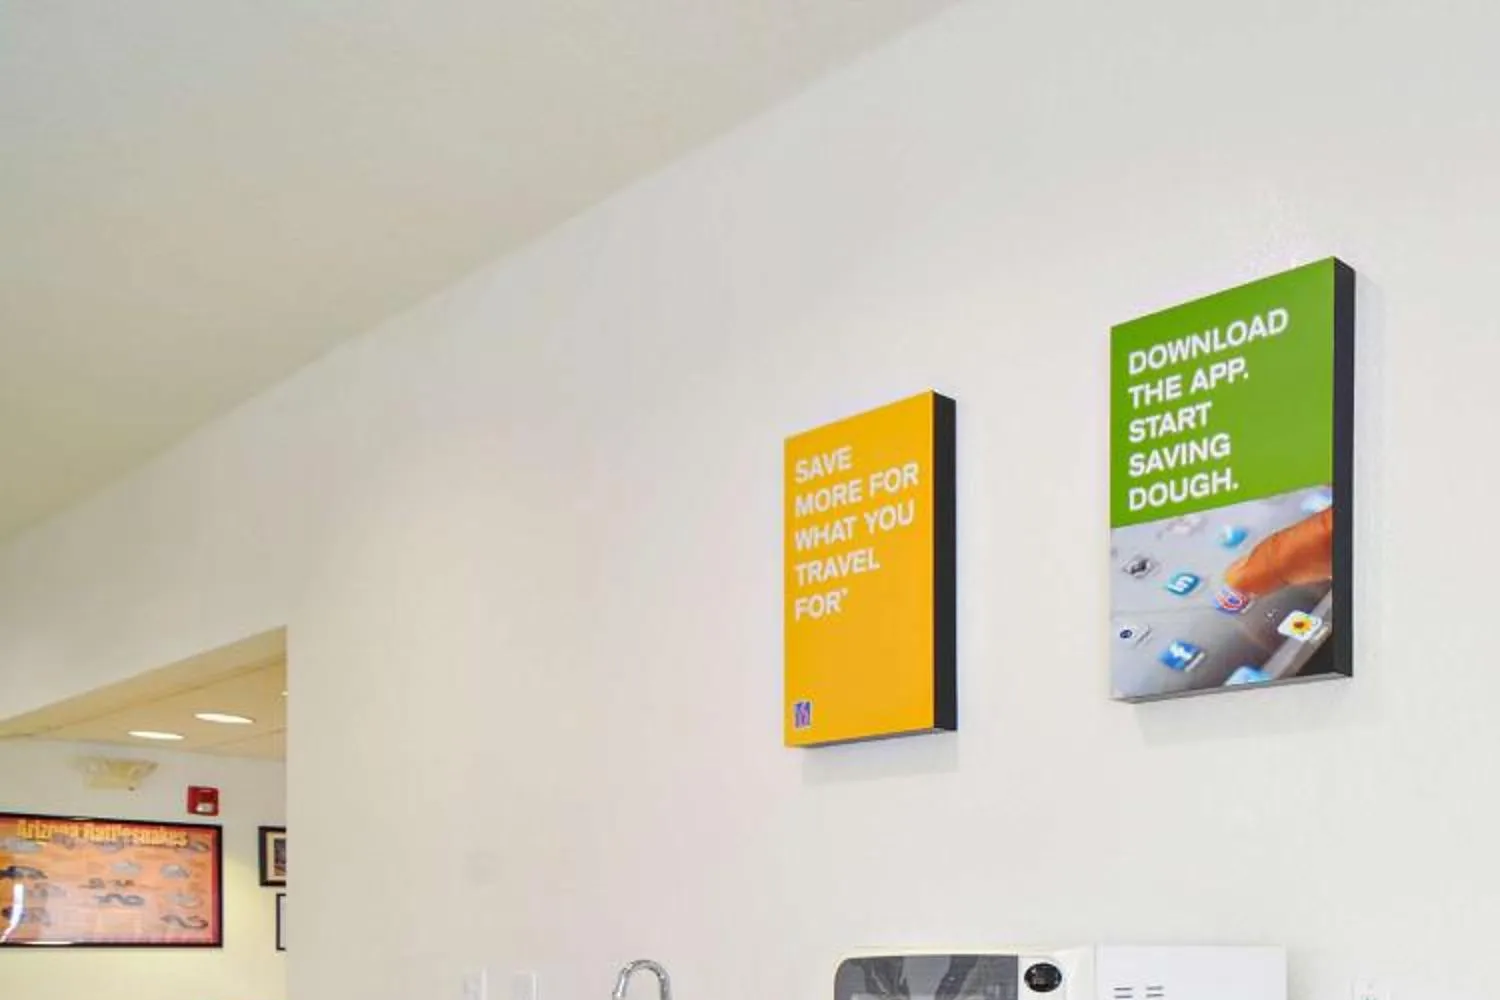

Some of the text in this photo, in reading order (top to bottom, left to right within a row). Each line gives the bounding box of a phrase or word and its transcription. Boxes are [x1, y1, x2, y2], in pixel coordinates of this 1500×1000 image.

[1128, 308, 1289, 374] DOWNLOAD
[1128, 356, 1250, 409] THE APP.
[1128, 402, 1212, 444] START
[794, 446, 853, 485] SAVE
[1128, 433, 1232, 478] SAVING
[794, 463, 920, 518] MORE FOR
[1128, 467, 1240, 513] DOUGH.
[794, 500, 915, 553] WHAT YOU
[794, 548, 881, 587] TRAVEL
